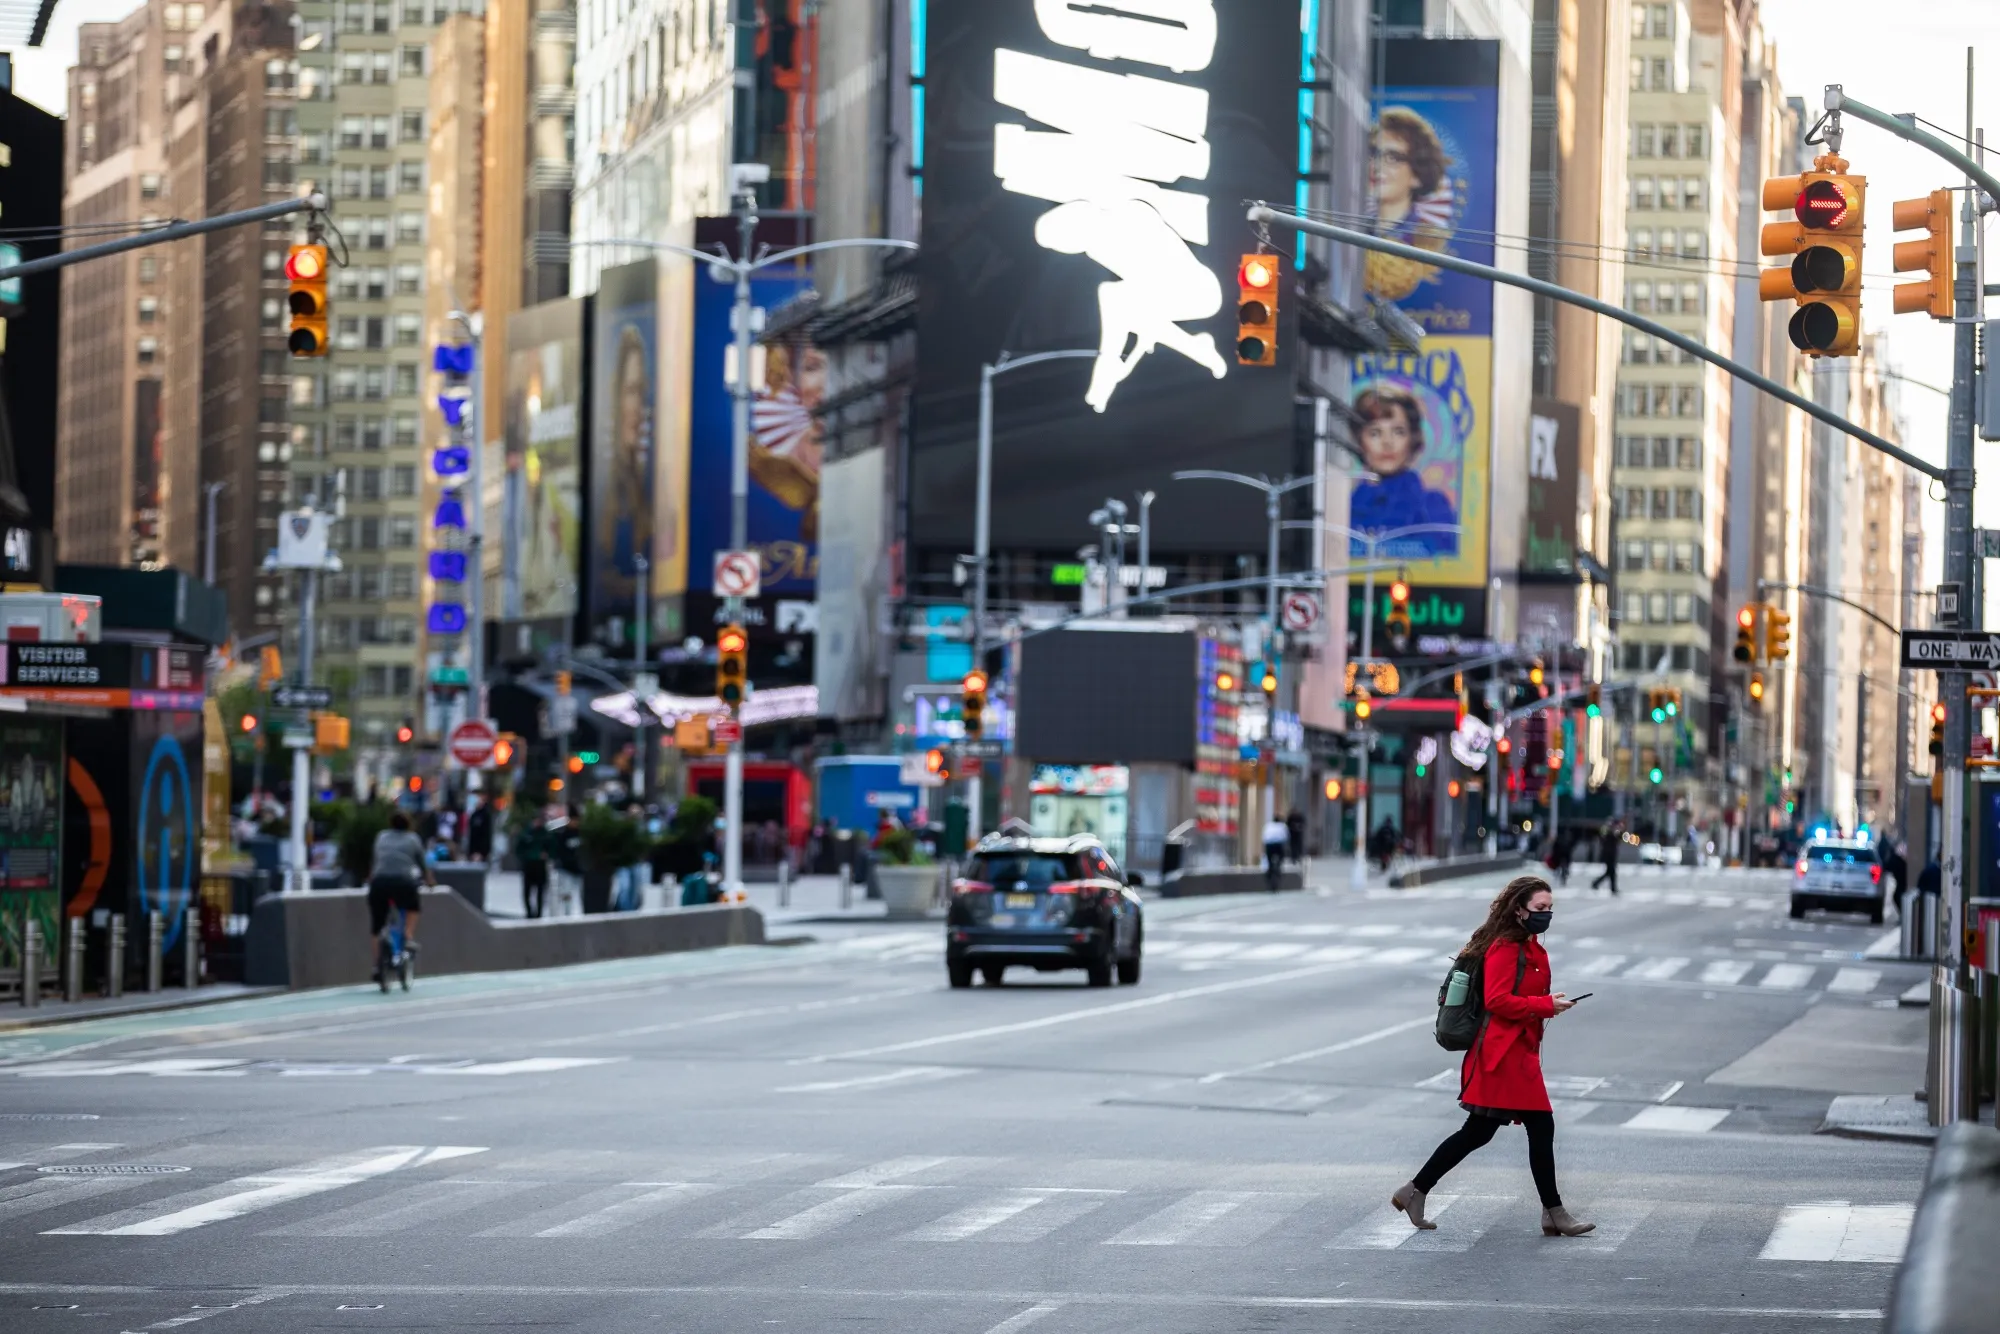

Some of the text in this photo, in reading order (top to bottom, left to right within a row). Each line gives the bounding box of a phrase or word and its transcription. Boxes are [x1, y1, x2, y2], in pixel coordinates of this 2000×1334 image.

[18, 646, 87, 664] VISITOR
[1918, 641, 1953, 658] ONE
[18, 666, 100, 683] SERVICES
